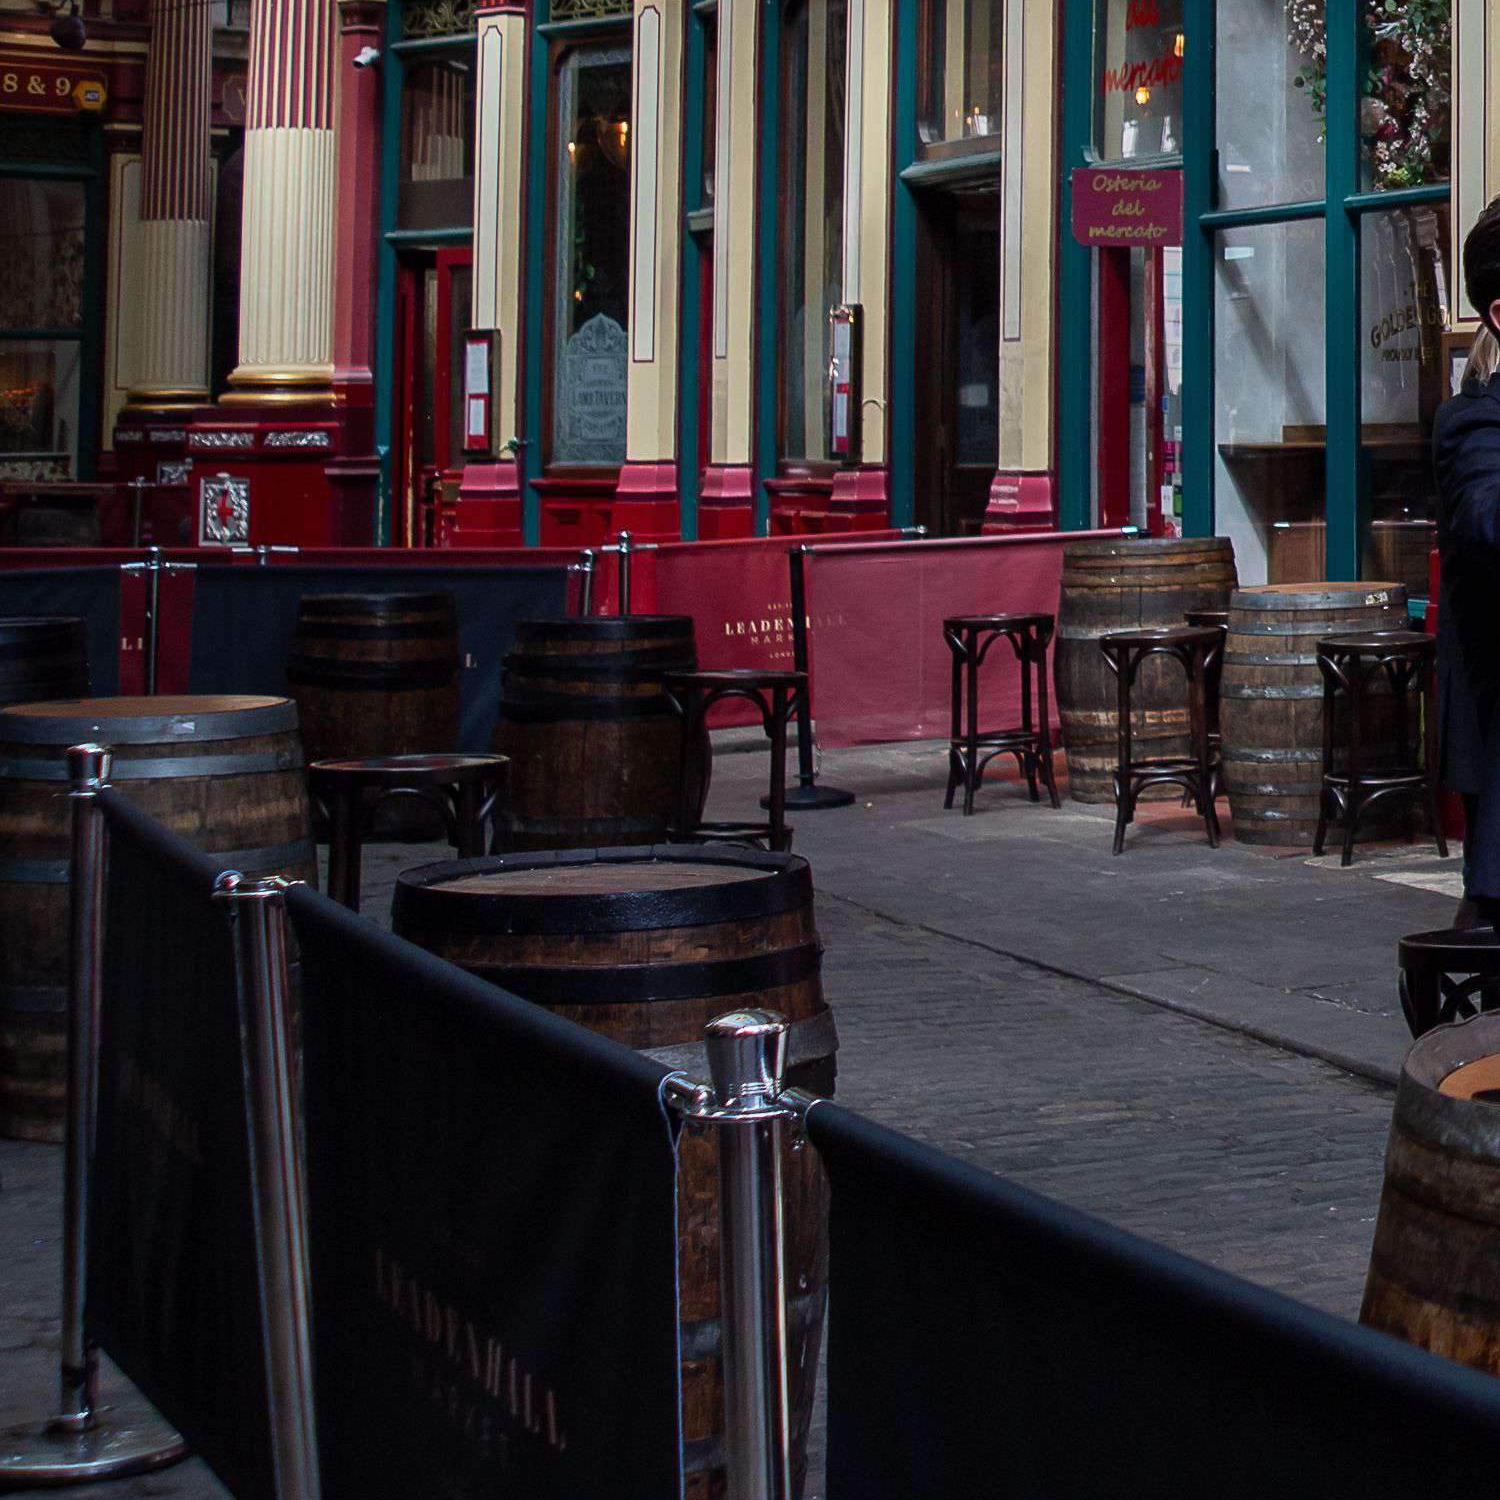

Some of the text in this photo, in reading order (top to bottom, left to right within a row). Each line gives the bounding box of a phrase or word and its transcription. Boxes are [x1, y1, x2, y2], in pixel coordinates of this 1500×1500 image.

[3, 73, 71, 97] 8 & 9
[1092, 174, 1162, 192] Osteria
[1112, 198, 1145, 216] del
[1088, 222, 1168, 240] mercato
